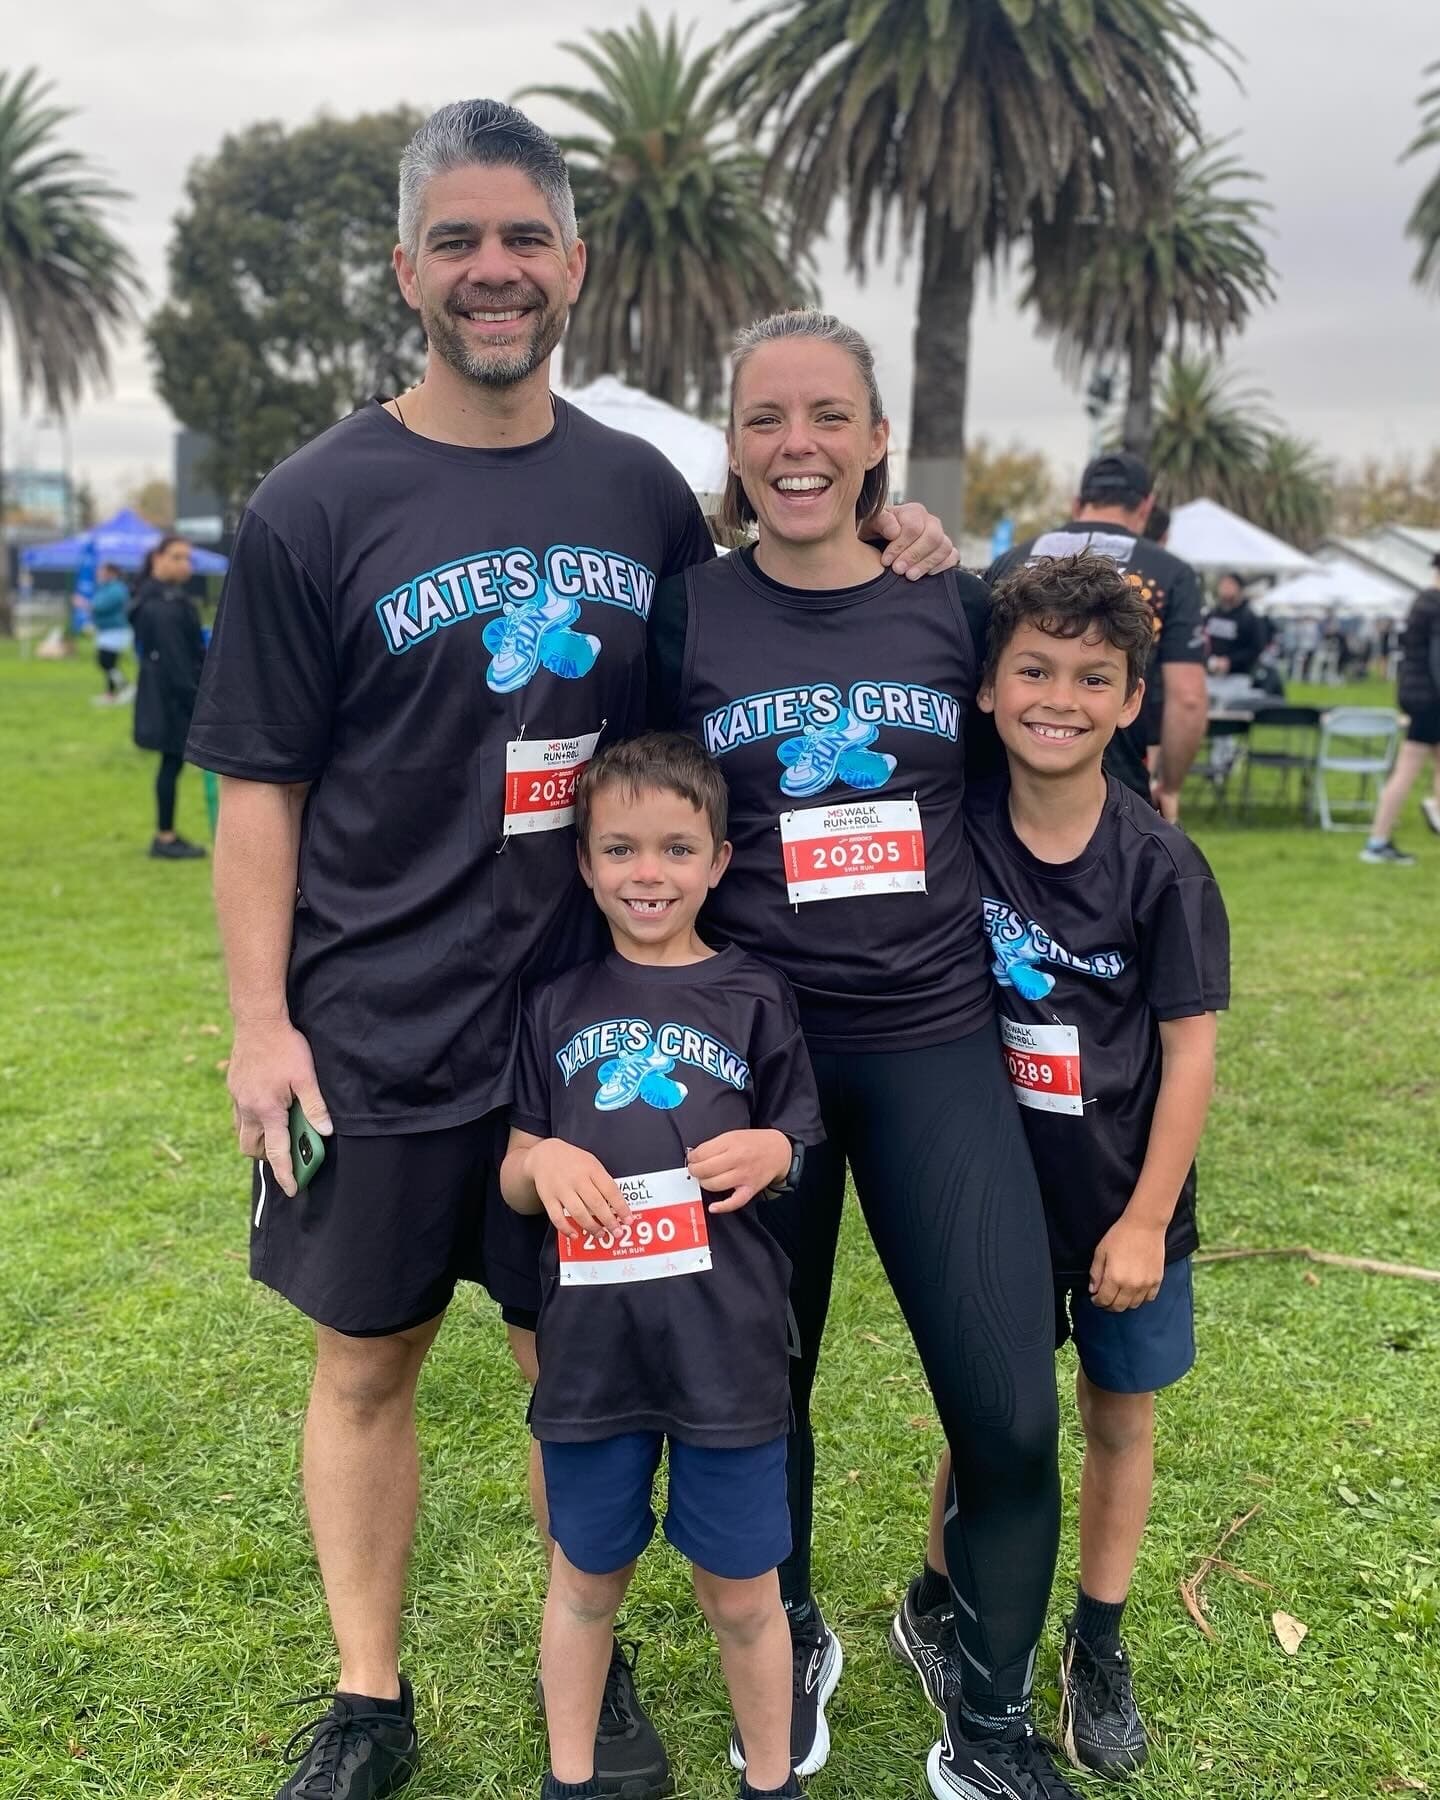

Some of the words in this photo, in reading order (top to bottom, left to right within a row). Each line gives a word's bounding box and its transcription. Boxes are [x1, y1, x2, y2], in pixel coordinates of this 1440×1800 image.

[382, 551, 538, 650] KATE'S
[549, 549, 654, 617] CREW
[705, 688, 840, 753] KATE'S
[854, 686, 958, 738] CREW
[844, 806, 876, 816] WALK
[812, 842, 900, 869] 20205
[660, 1026, 748, 1088] CREW
[1004, 1053, 1053, 1084] 0289
[582, 1217, 676, 1250] 20290
